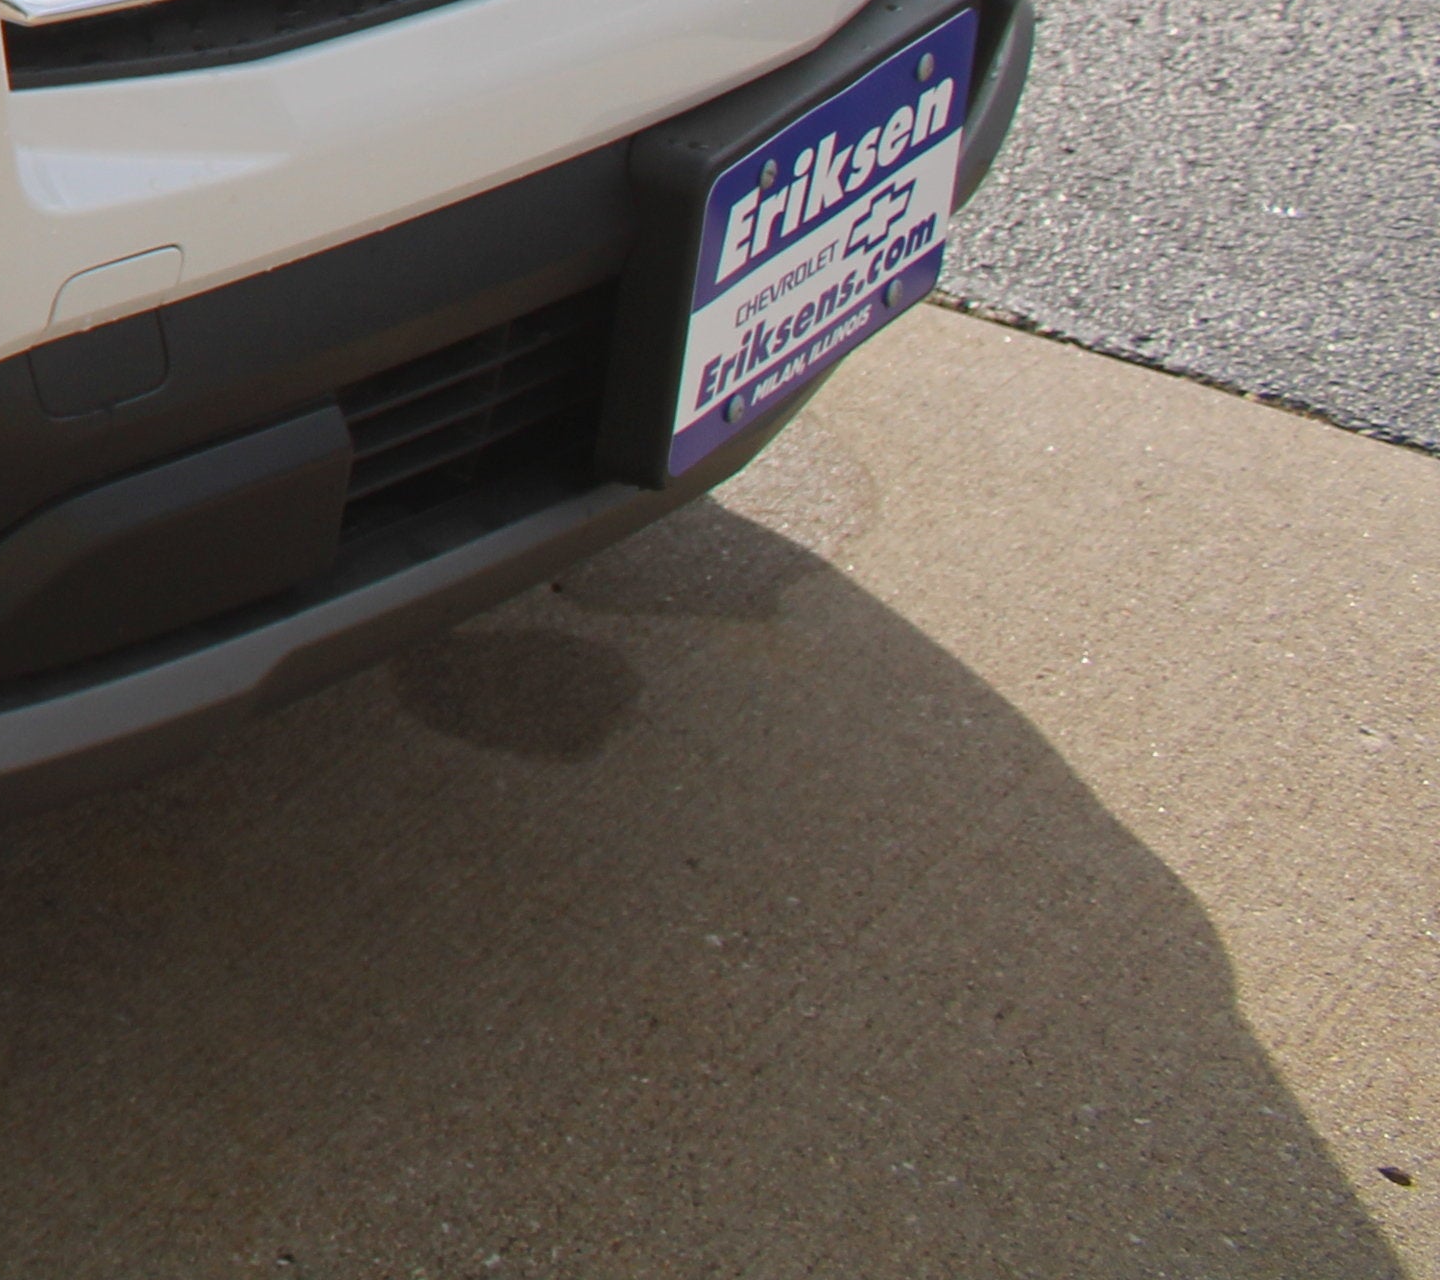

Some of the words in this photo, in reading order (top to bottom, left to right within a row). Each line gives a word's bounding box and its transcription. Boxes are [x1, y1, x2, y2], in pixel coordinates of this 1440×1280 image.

[715, 76, 955, 286] Eriksen
[694, 212, 938, 411] Eriksens.com
[735, 239, 840, 328] CHEVROLET
[806, 302, 873, 366] ILLINOIS
